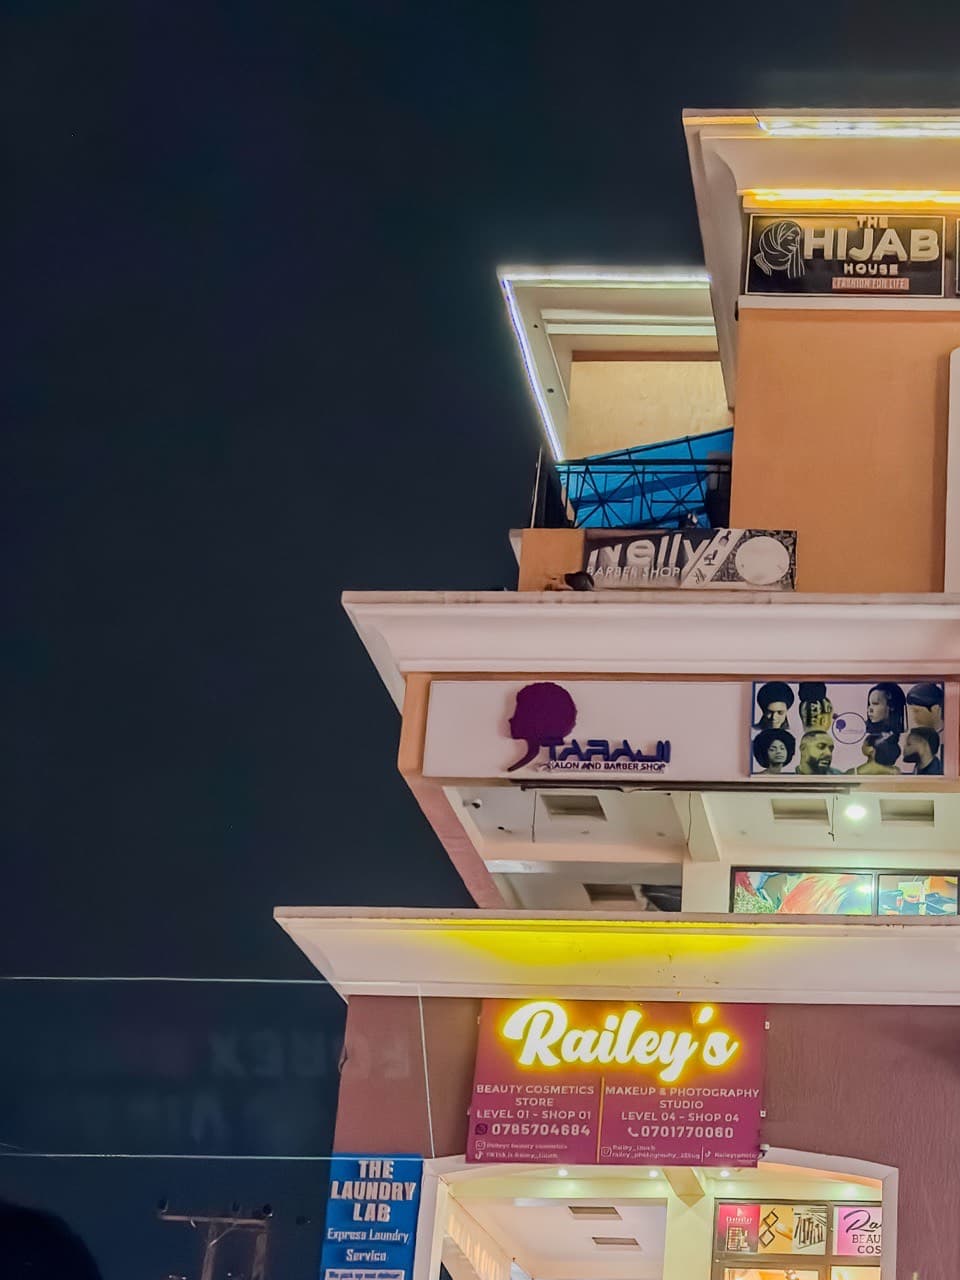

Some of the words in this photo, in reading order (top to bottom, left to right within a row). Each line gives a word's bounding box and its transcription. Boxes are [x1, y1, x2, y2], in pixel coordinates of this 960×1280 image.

[857, 215, 888, 229] THE
[803, 228, 940, 262] HIJAB
[844, 263, 899, 275] HOUSE
[643, 566, 681, 577] SHOP
[582, 762, 602, 770] AND
[604, 762, 639, 771] BARBER
[640, 763, 666, 772] SHOP
[503, 1000, 739, 1083] Railey's
[476, 1084, 522, 1095] BEAUTY
[525, 1084, 595, 1096] COSMETICS
[605, 1086, 656, 1096] MAKEUP
[670, 1087, 760, 1099] PHOTOGRAPHY
[515, 1096, 554, 1107] STORE
[659, 1100, 704, 1110] STUDIO
[476, 1109, 514, 1120] LEVEL
[517, 1110, 530, 1120] 01
[542, 1110, 575, 1120] SHOP
[578, 1111, 592, 1120] 01
[621, 1111, 658, 1121] LEVEL
[661, 1112, 676, 1122] 04
[688, 1112, 722, 1123] SHOP
[725, 1113, 739, 1123] 04
[492, 1123, 592, 1137] 0785704684
[358, 1159, 395, 1179] THE
[330, 1180, 416, 1201] LAUNDRY
[352, 1203, 391, 1223] LAB
[844, 1209, 882, 1233] Ra
[327, 1227, 367, 1242] Express
[369, 1228, 409, 1245] Laundry
[852, 1234, 881, 1244] BEAU
[345, 1249, 387, 1262] Service
[857, 1245, 882, 1254] COS
